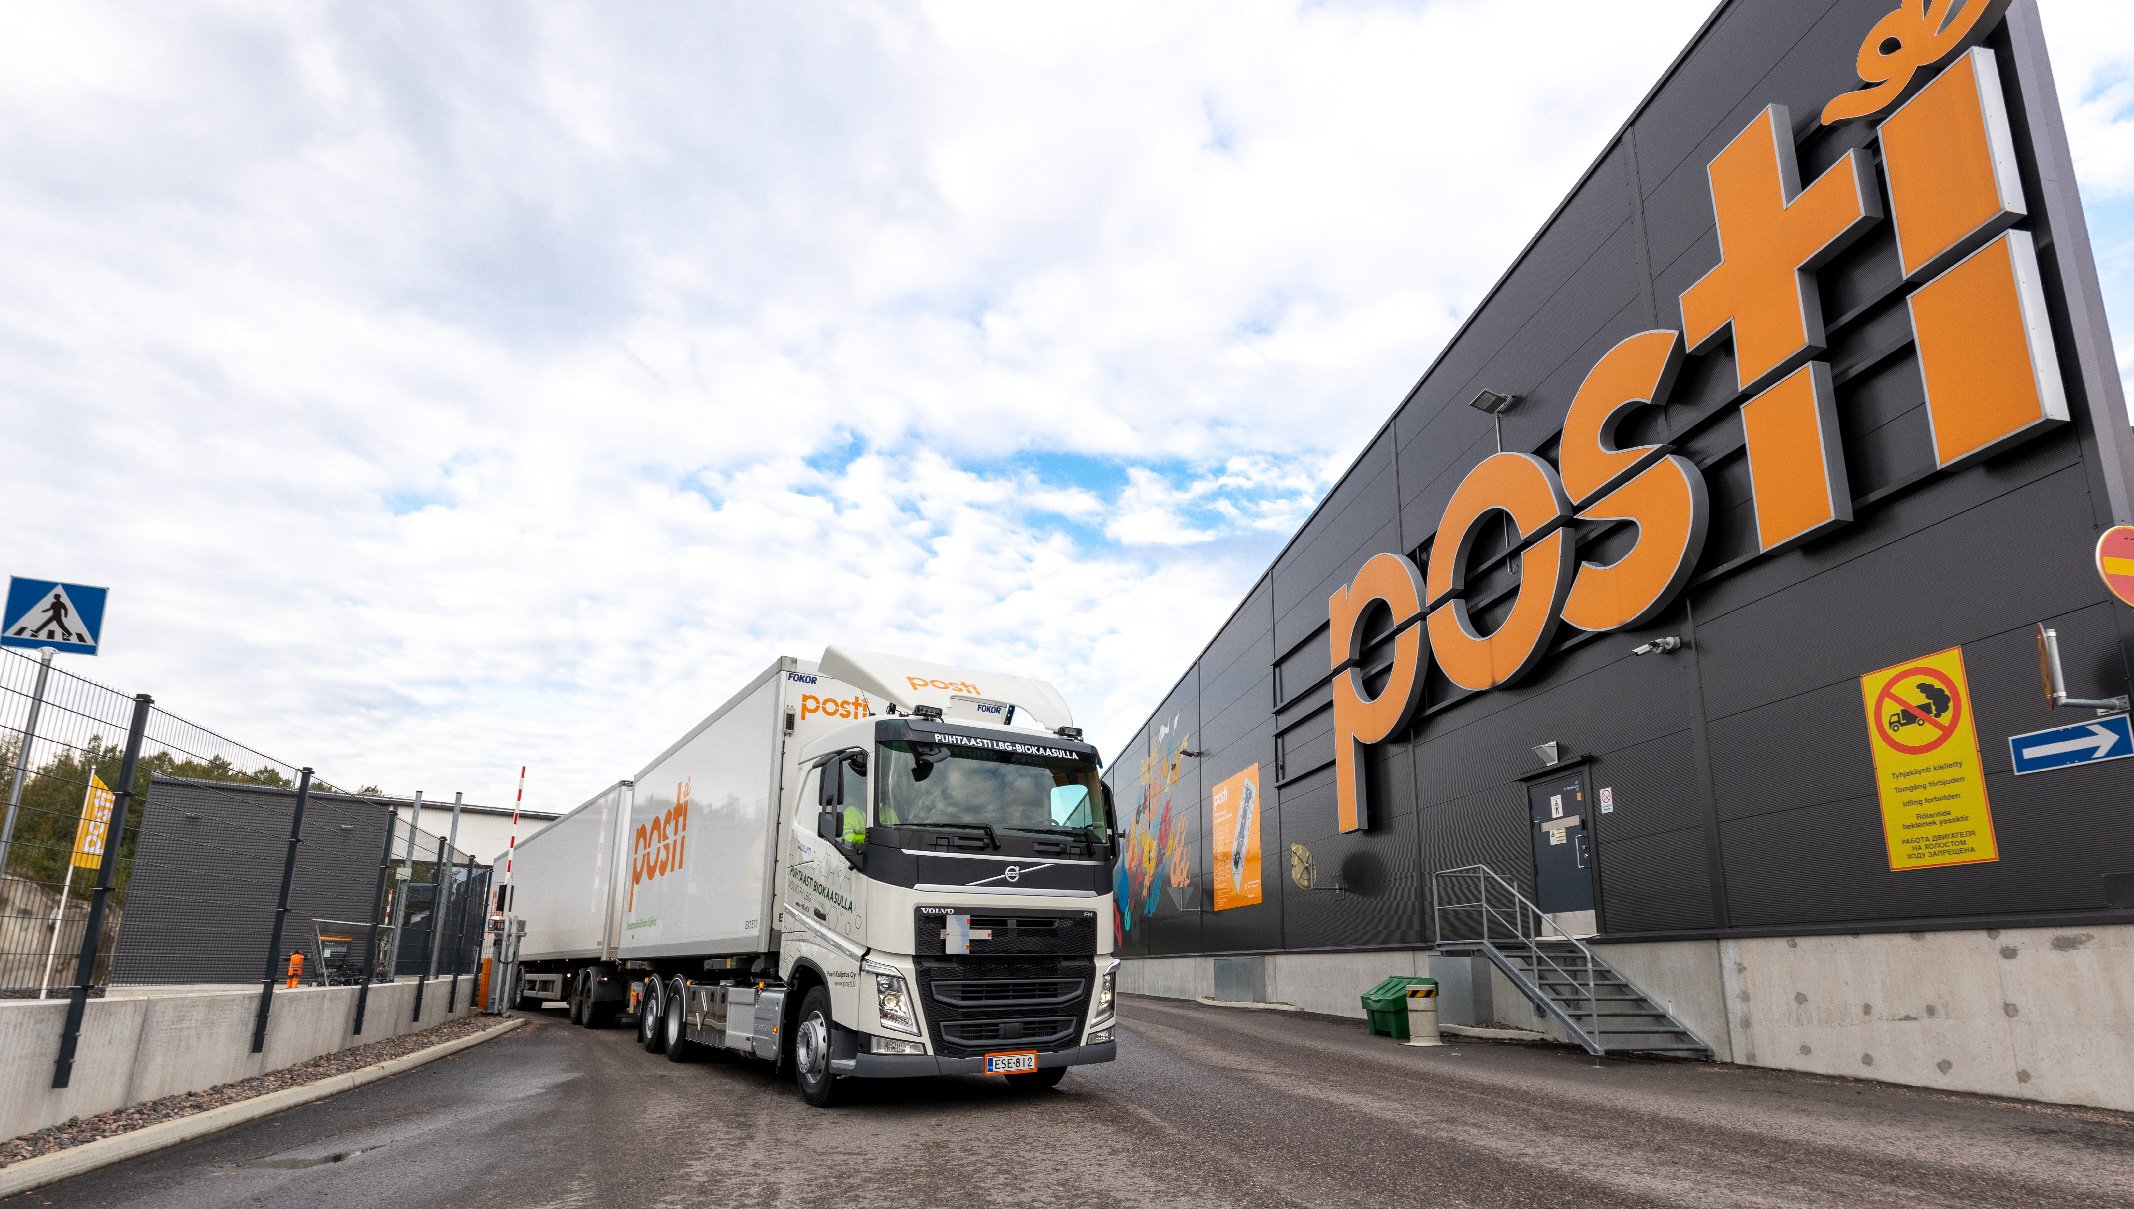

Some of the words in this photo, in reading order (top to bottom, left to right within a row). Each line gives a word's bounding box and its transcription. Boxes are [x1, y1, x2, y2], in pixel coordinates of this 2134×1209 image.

[1329, 46, 2070, 833] posti
[788, 673, 818, 684] FOKOR
[907, 676, 981, 696] posti
[801, 694, 868, 720] posti
[977, 704, 1002, 715] FOKOR
[934, 733, 992, 749] PUHTAASTI
[993, 739, 1080, 761] LBG-BIOKAASULLA
[1933, 761, 1963, 772] kielletty
[1894, 783, 1927, 794] Tomgång
[1928, 776, 1966, 787] förbjuden
[1902, 798, 1923, 808] Idling
[1924, 793, 1961, 804] forbidden
[83, 788, 116, 855] posti
[1902, 820, 1937, 830] beklemek
[1902, 836, 1930, 845] РАБОТА
[1931, 830, 1976, 841] ДВИГАТЕЛЯ
[628, 781, 689, 912] posti
[1912, 844, 1923, 852] НА
[920, 907, 954, 915] VOLVO
[994, 1056, 1033, 1070] ESE-812
